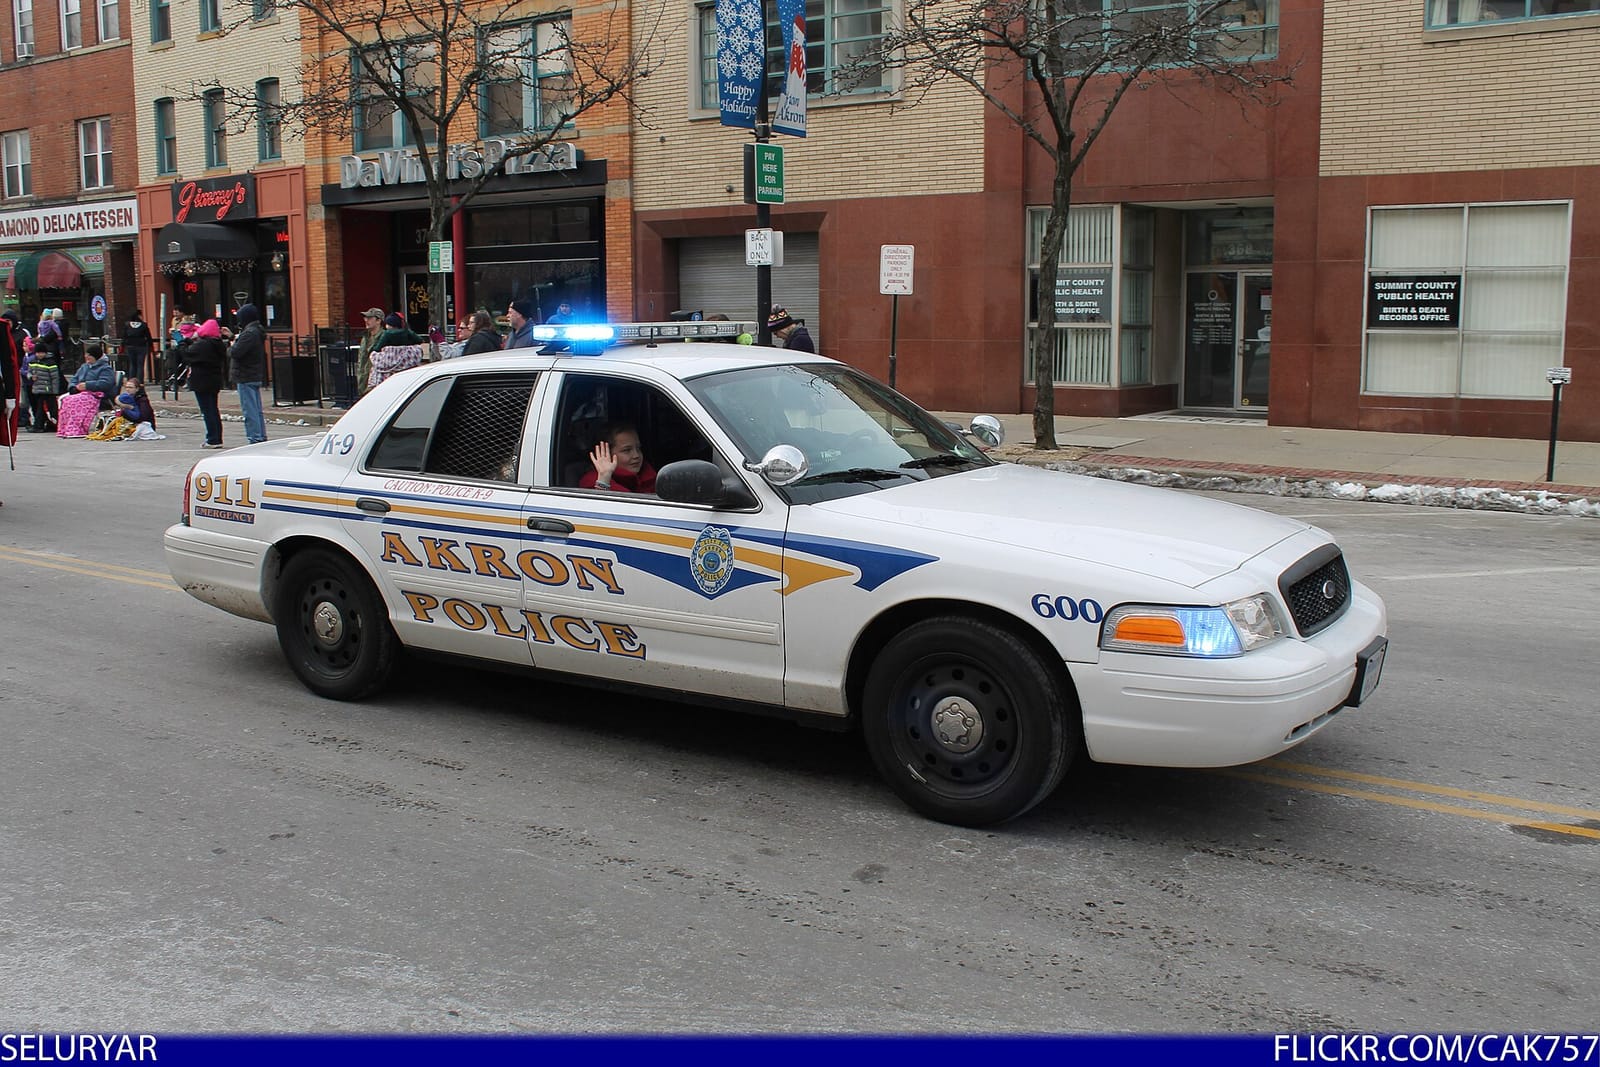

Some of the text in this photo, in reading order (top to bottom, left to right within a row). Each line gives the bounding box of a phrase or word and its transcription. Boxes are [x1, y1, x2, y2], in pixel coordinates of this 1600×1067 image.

[724, 81, 755, 101] Happy
[720, 99, 758, 119] Holidays
[776, 106, 805, 124] Akron
[764, 152, 776, 161] PAY
[762, 164, 778, 173] HERE
[764, 175, 776, 184] FOR
[758, 186, 783, 196] PARKING
[176, 181, 246, 223] Jimmy's
[0, 207, 133, 238] AMOND DELICATESSEN
[750, 234, 768, 242] BACK
[755, 242, 764, 250] IN
[750, 251, 768, 259] ONLY
[1374, 281, 1457, 290] SUMMIT COUNTY
[1377, 292, 1454, 300] PUBLIC HEALTH
[320, 433, 355, 455] K-9
[195, 472, 256, 508] 911
[431, 484, 475, 498] POLICE
[471, 487, 494, 500] K-9
[196, 506, 254, 524] EMERGENCY
[381, 531, 624, 595] AKRON
[1031, 593, 1104, 624] 600
[401, 590, 646, 660] POLICE
